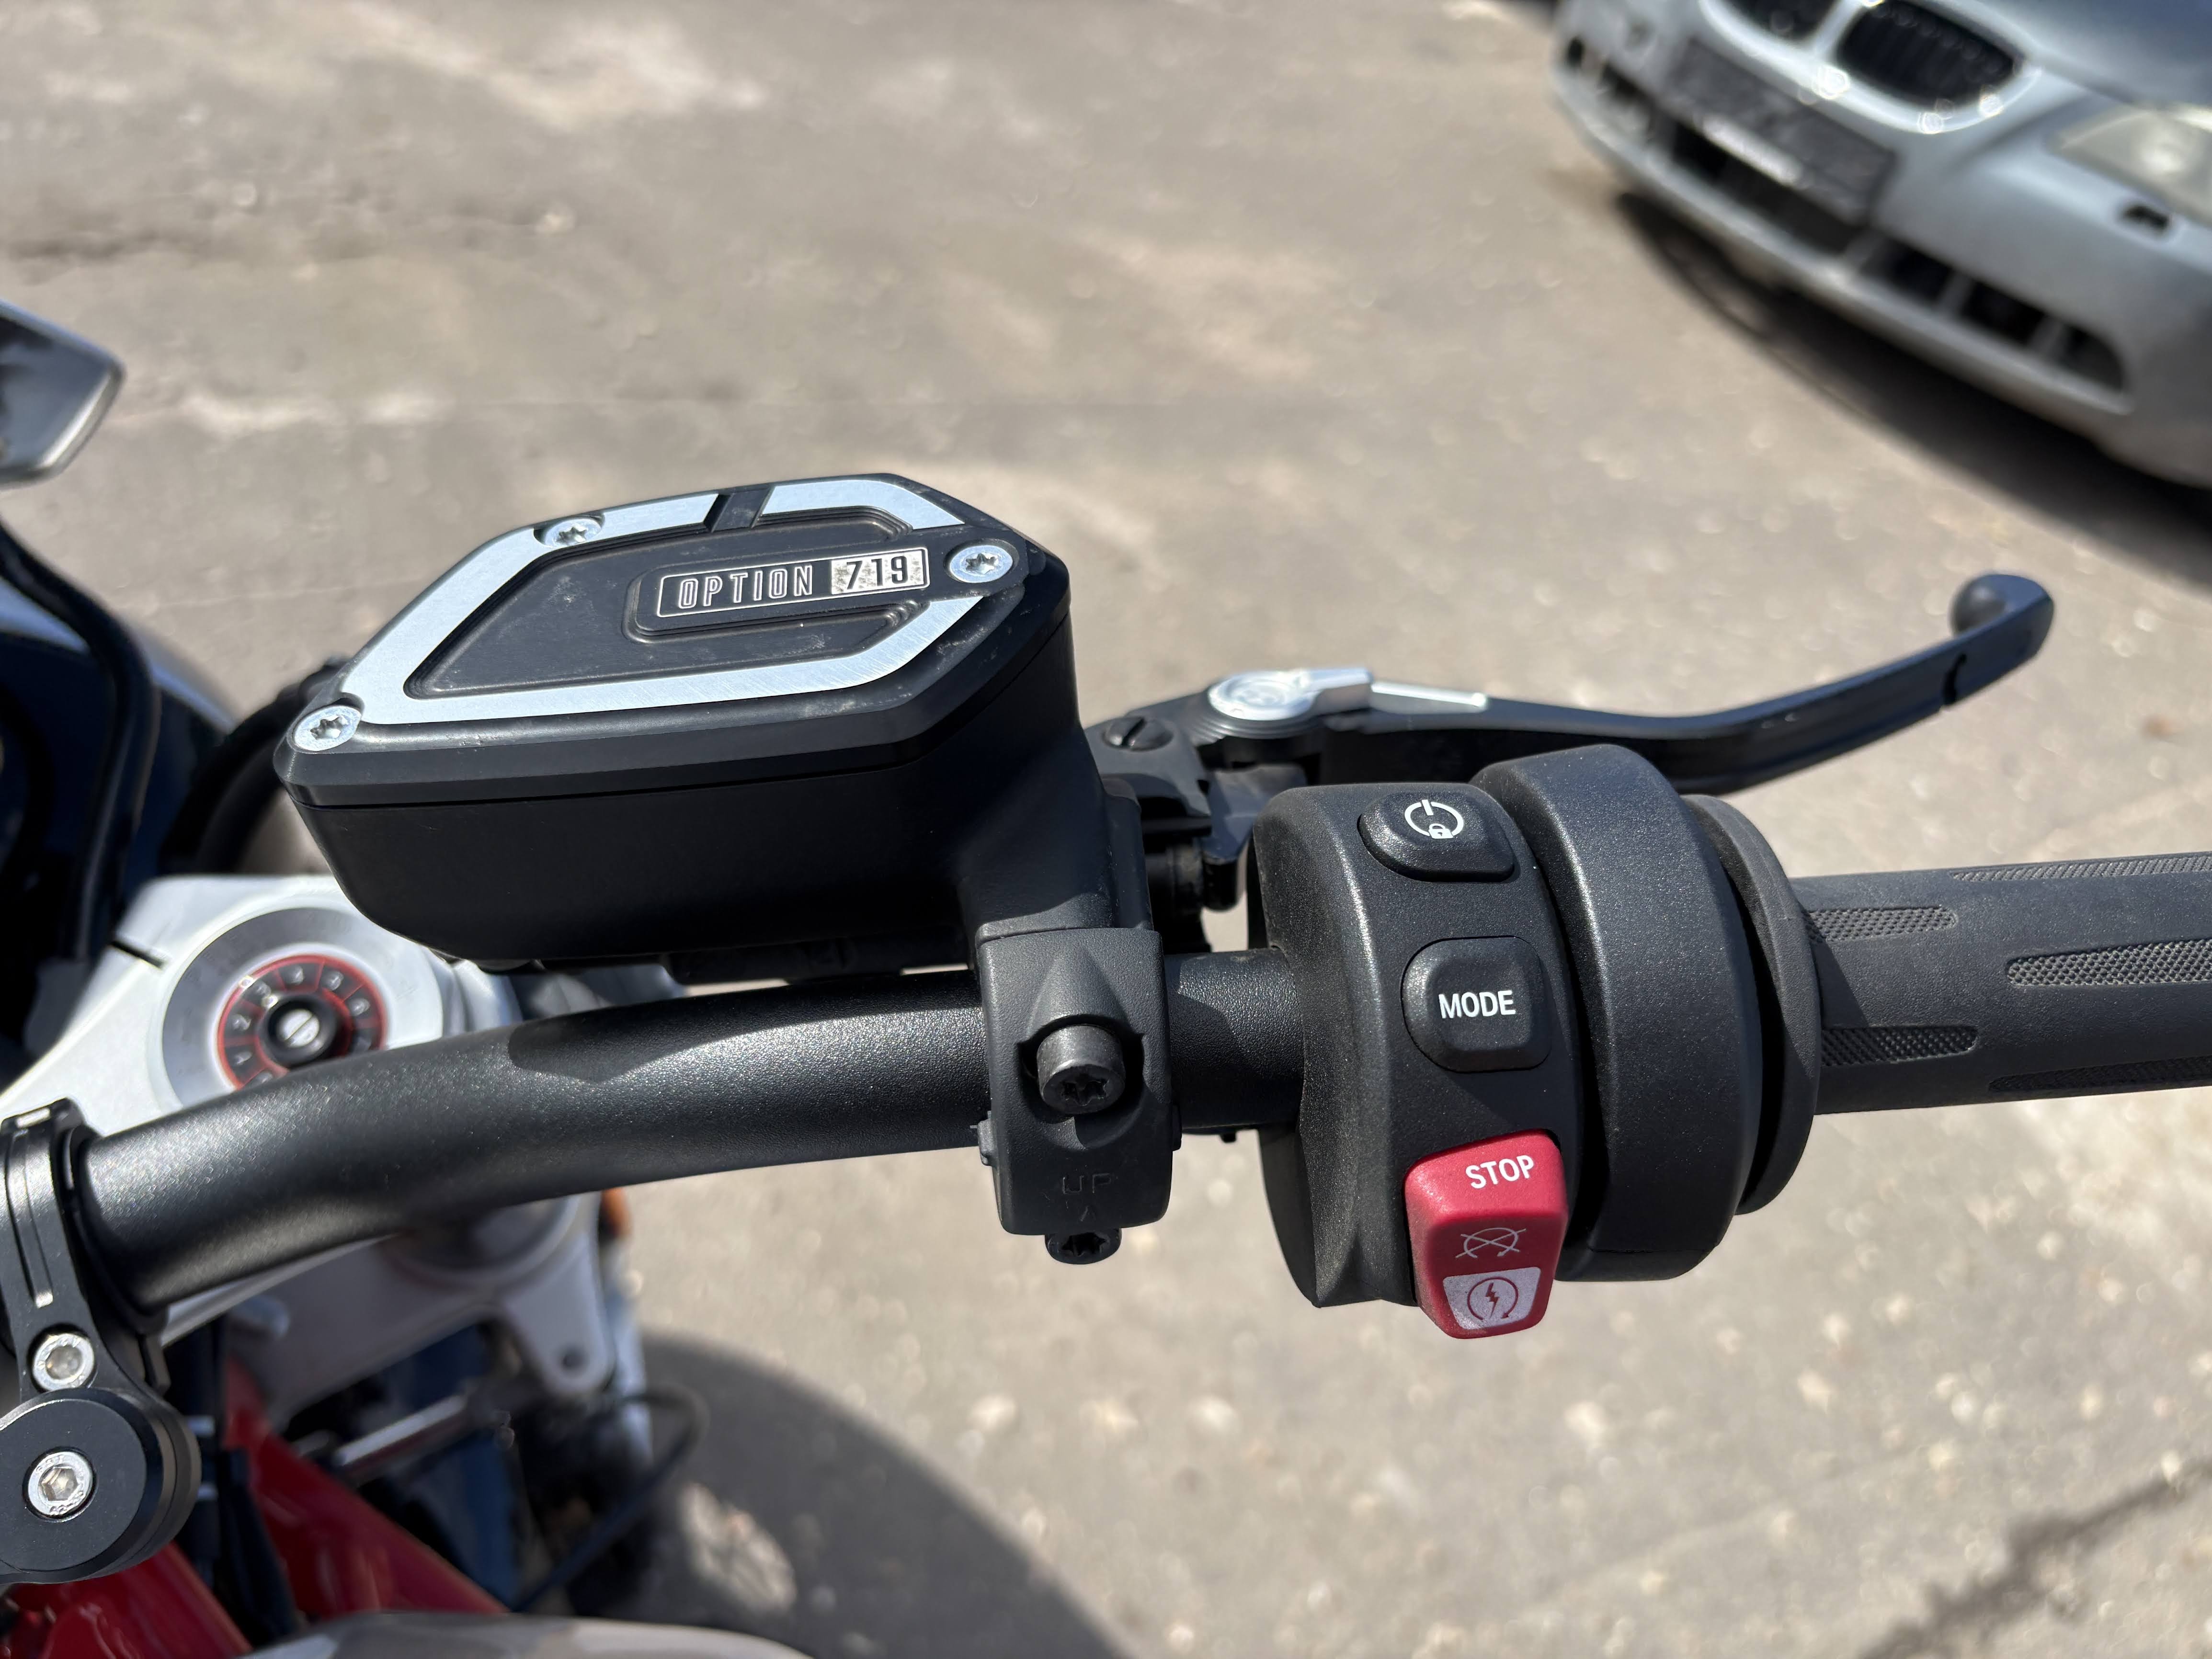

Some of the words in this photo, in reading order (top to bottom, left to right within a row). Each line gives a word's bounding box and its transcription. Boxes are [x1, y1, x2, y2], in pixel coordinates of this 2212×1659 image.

[678, 564, 813, 609] OPTION
[845, 555, 908, 590] 719
[1438, 990, 1516, 1019] MODE
[1061, 1173, 1112, 1194] UP
[1465, 1155, 1534, 1189] STOP
